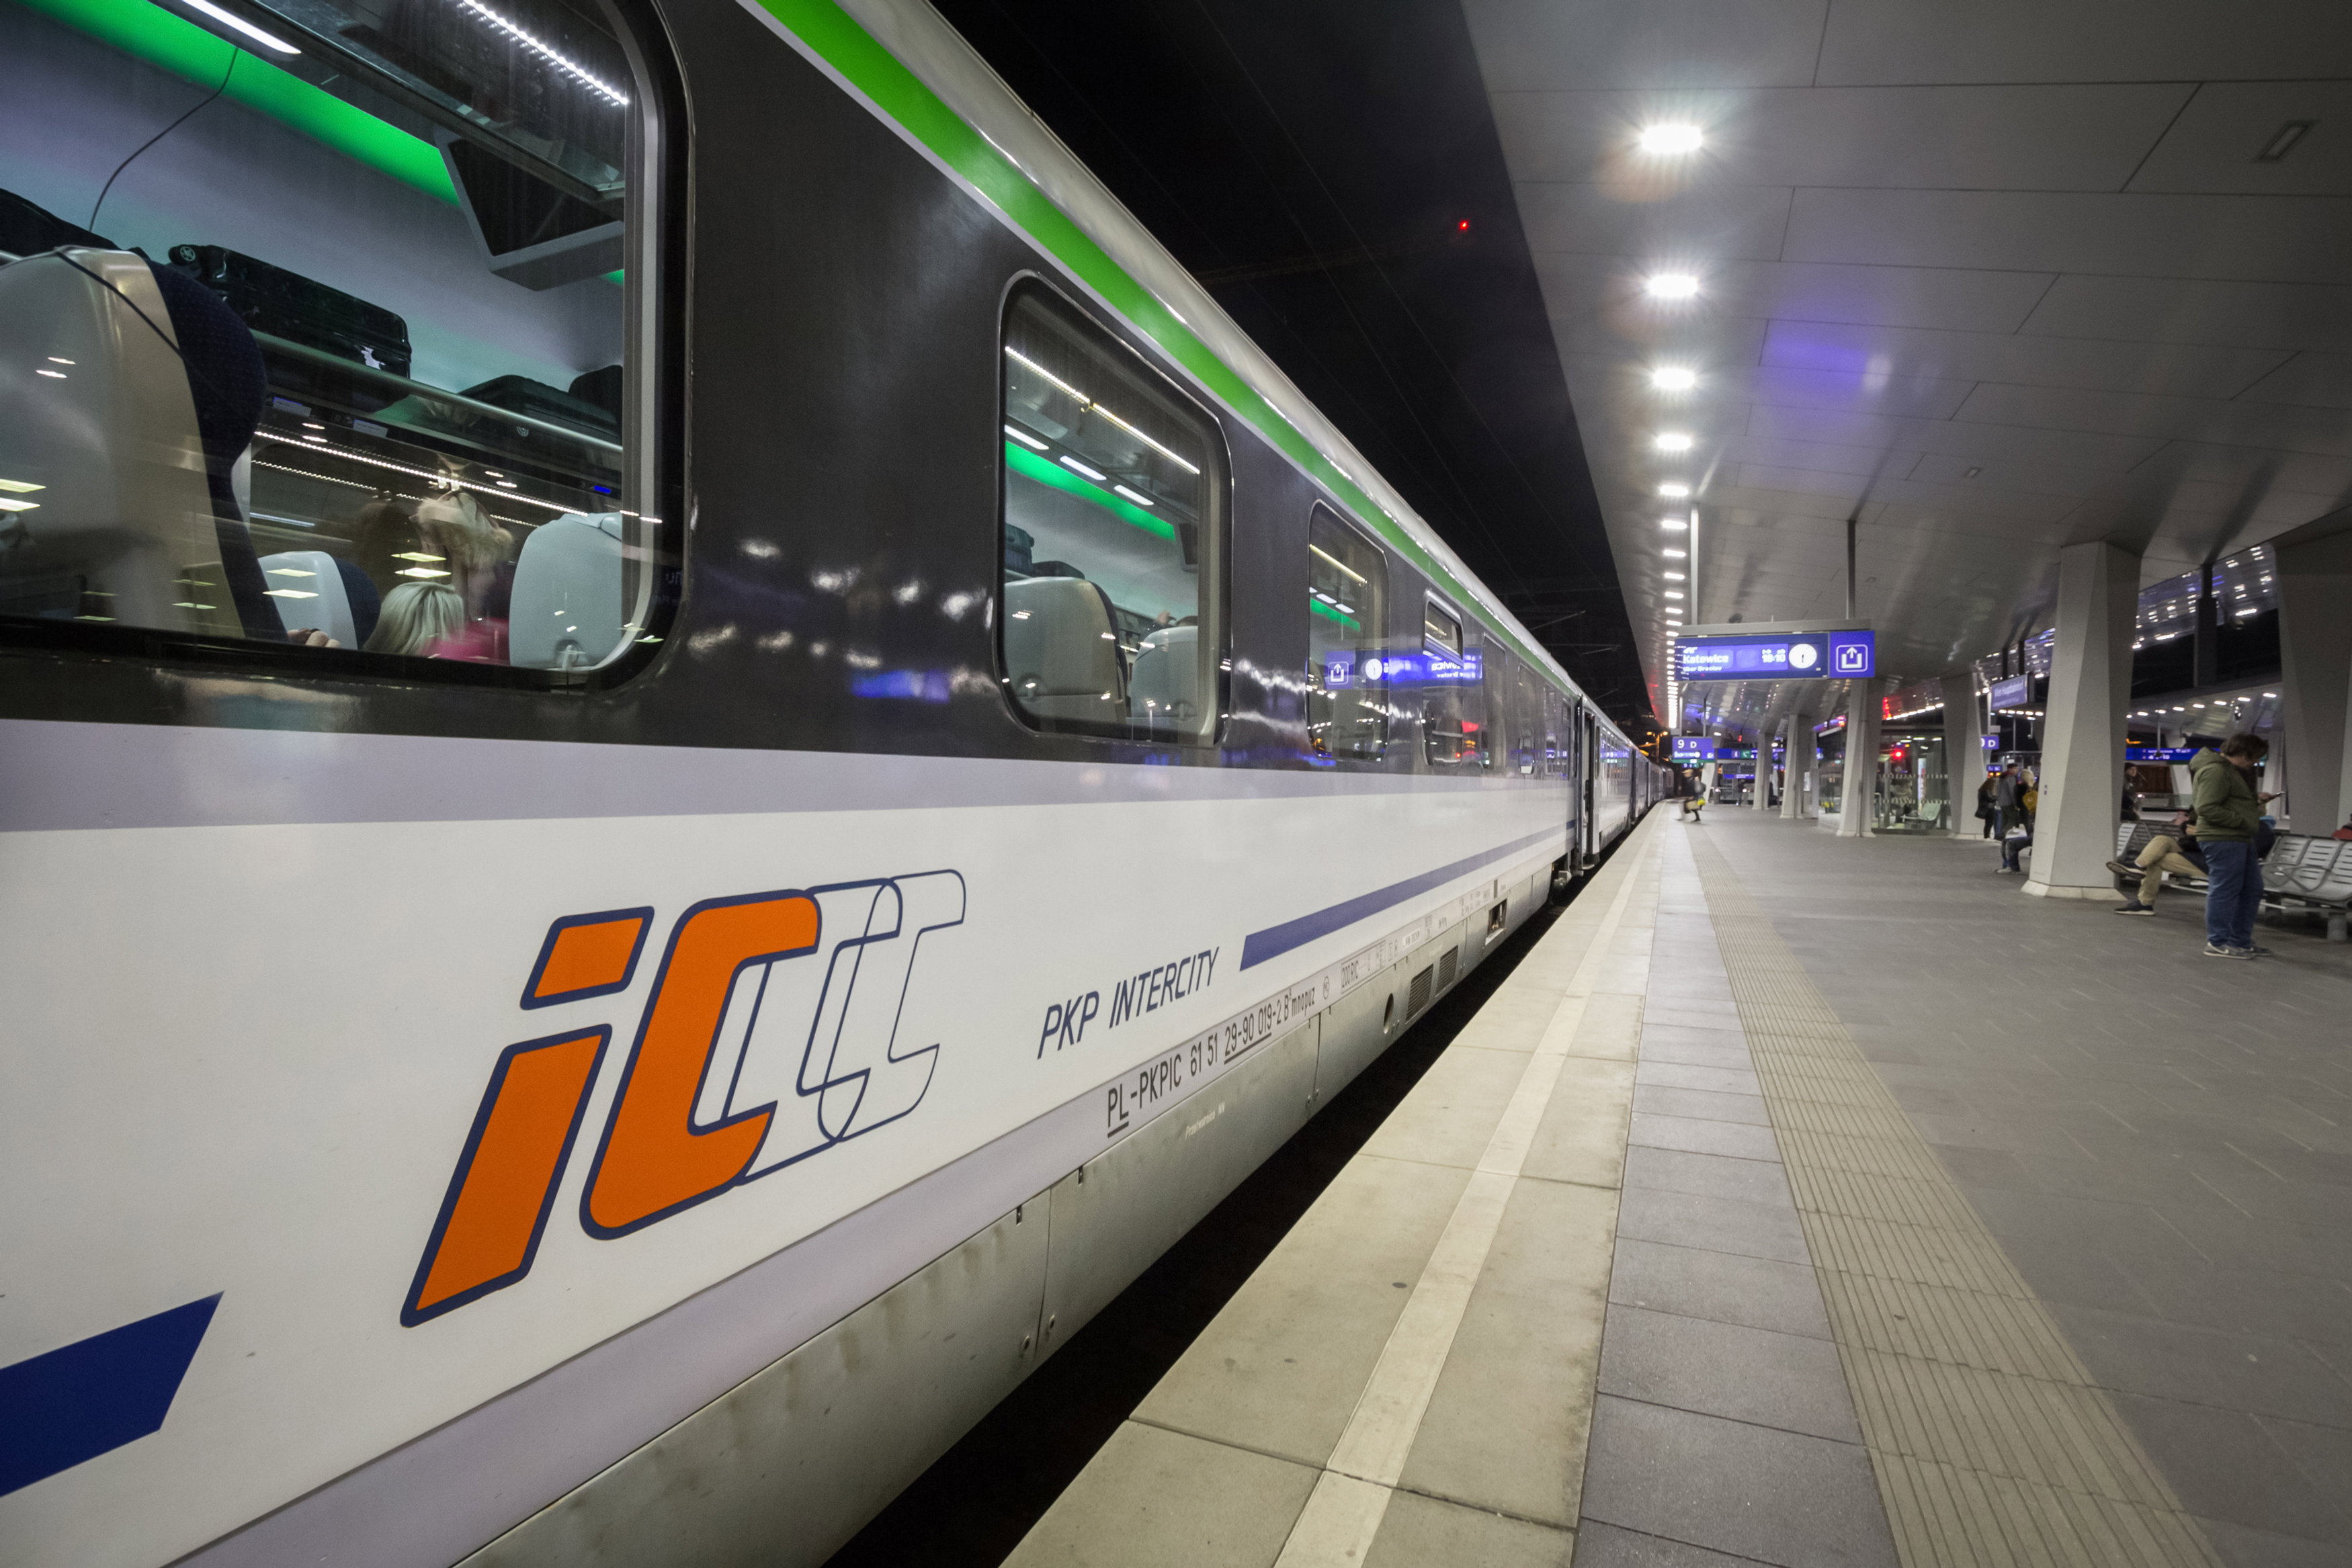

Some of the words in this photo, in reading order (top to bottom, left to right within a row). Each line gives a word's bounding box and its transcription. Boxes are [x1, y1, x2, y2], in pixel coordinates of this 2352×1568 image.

[1683, 654, 1729, 664] Katowice
[1677, 739, 1685, 749] 9
[1988, 740, 1997, 748] D
[1037, 990, 1100, 1059] PKP
[1109, 946, 1220, 1029] INTERCITY
[1107, 1053, 1183, 1129] PL-PKPIC
[1190, 1045, 1202, 1078] 61
[1207, 1032, 1218, 1067] 51
[1224, 1013, 1255, 1057] 29-90
[1258, 998, 1282, 1037] 019-2
